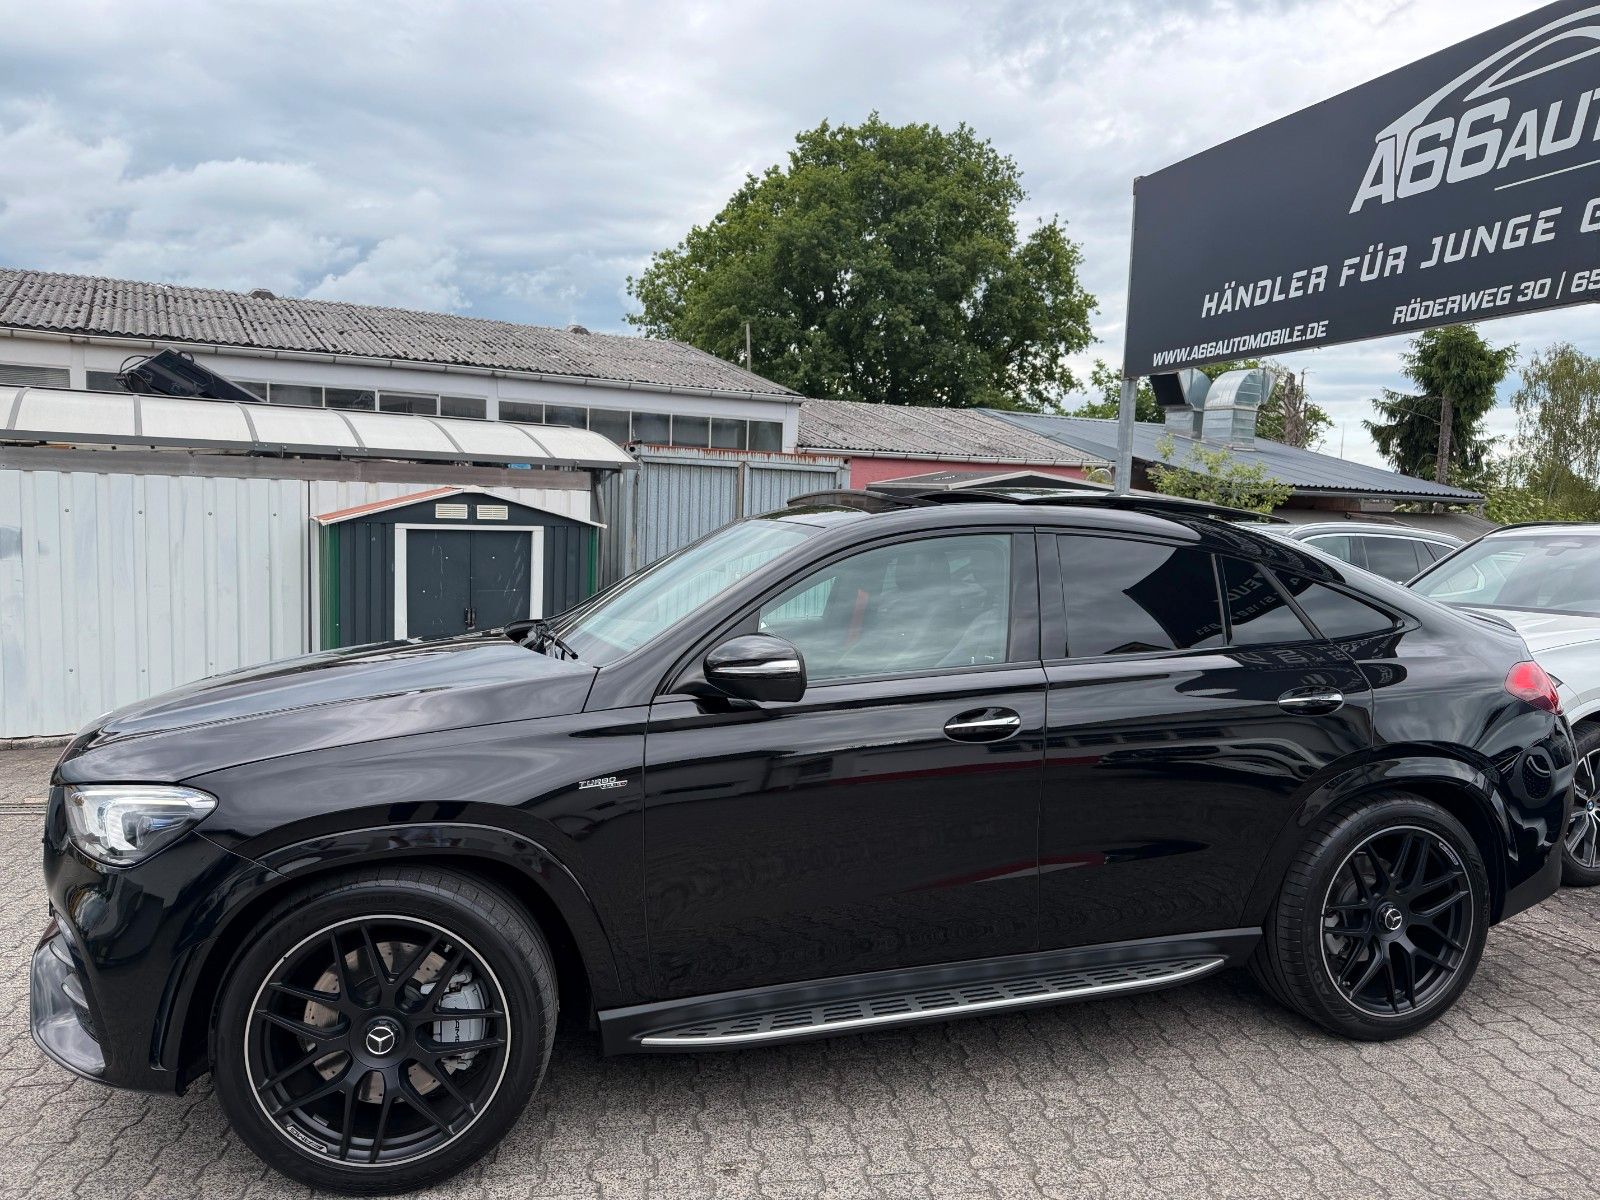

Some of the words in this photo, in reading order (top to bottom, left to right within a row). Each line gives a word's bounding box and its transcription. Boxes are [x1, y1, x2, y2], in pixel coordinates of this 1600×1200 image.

[1349, 88, 1600, 214] A66AU
[1201, 265, 1328, 318] HÄNDLER
[1339, 242, 1408, 287] FÜR
[1420, 206, 1562, 269] JUNGE
[1392, 284, 1513, 324] RÖDERWEG
[1517, 277, 1552, 302] 30
[1153, 320, 1329, 367] WWW.A66AUTOMOBILE.DE
[579, 777, 616, 788] TURBO
